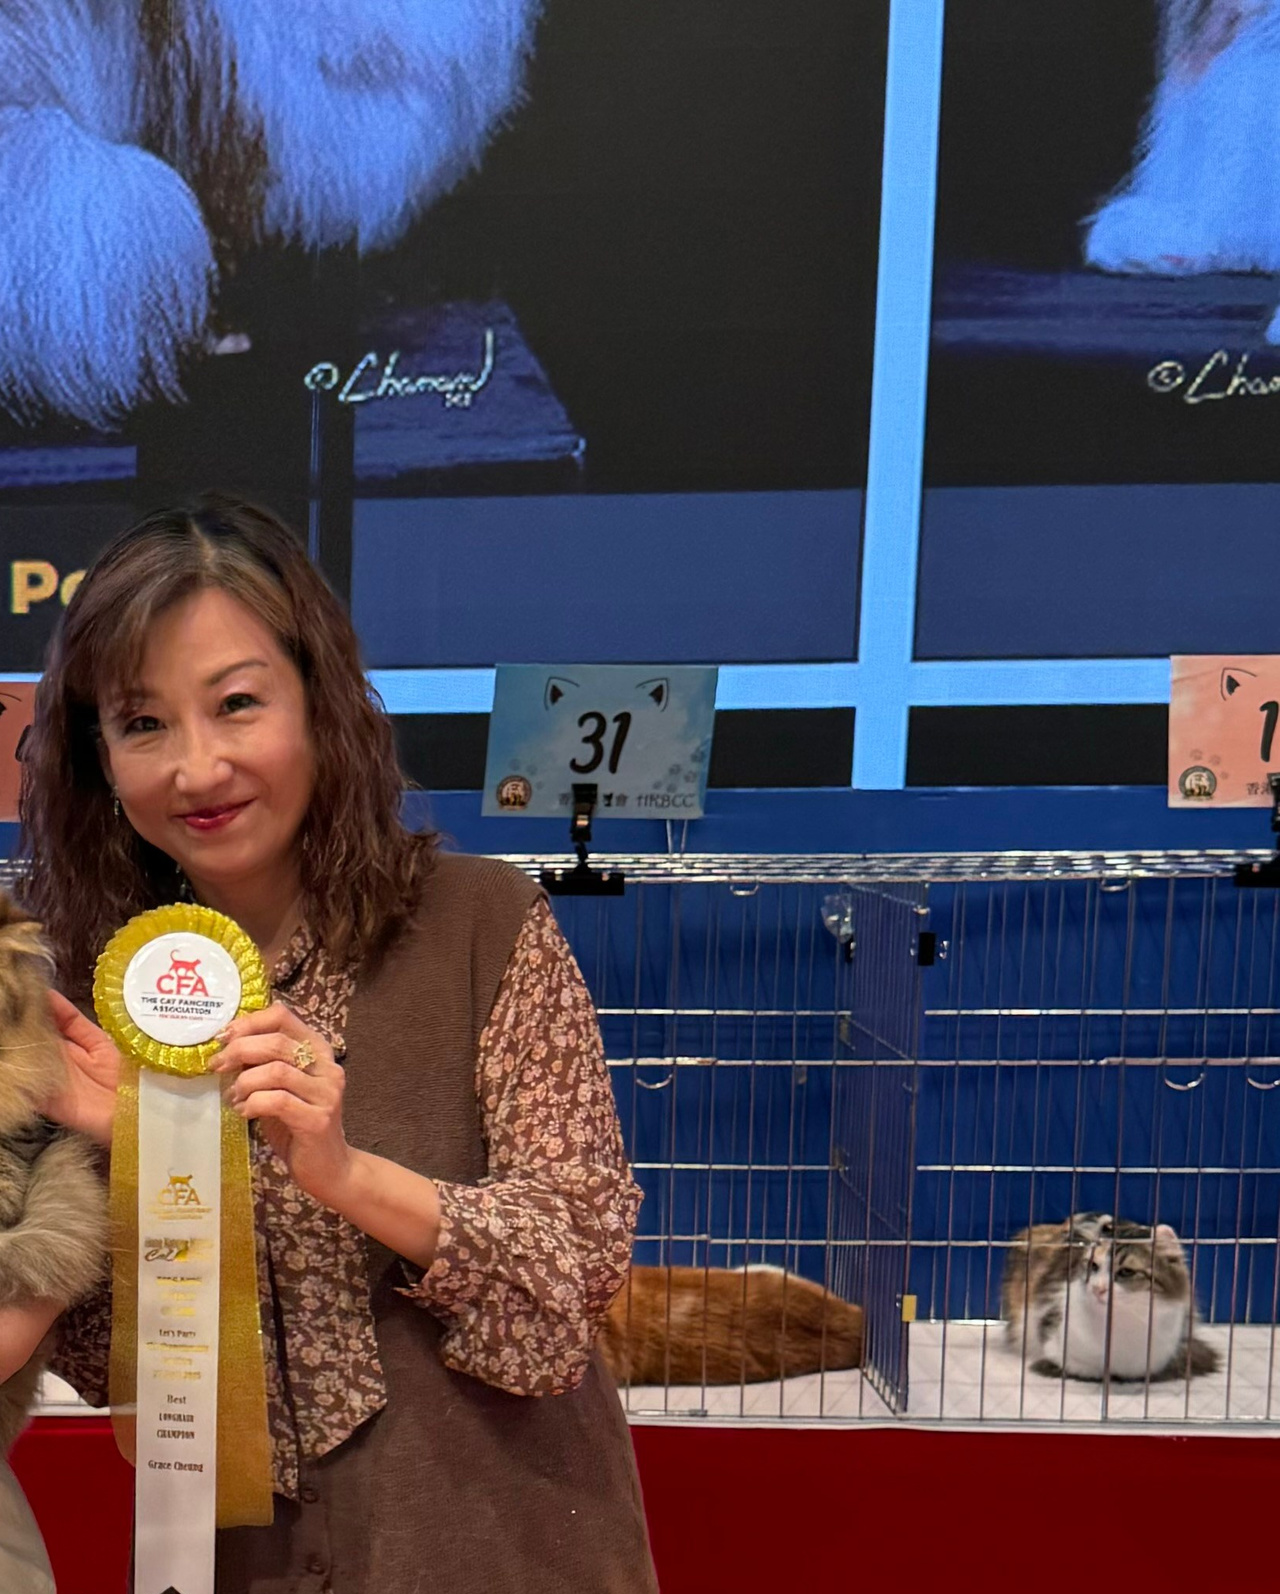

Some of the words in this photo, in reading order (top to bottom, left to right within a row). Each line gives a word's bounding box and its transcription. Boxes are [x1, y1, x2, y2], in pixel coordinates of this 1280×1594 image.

[570, 711, 631, 774] 31
[156, 973, 210, 997] CFA
[141, 997, 158, 1005] THE
[160, 997, 176, 1006] CAT
[152, 1004, 212, 1016] ASSOCIATION
[158, 1187, 201, 1206] CFA
[167, 1394, 187, 1405] Best
[158, 1412, 195, 1423] LONGHAIR
[156, 1429, 196, 1440] CHAMPION
[147, 1460, 172, 1471] Grace
[173, 1461, 204, 1473] Cheung
